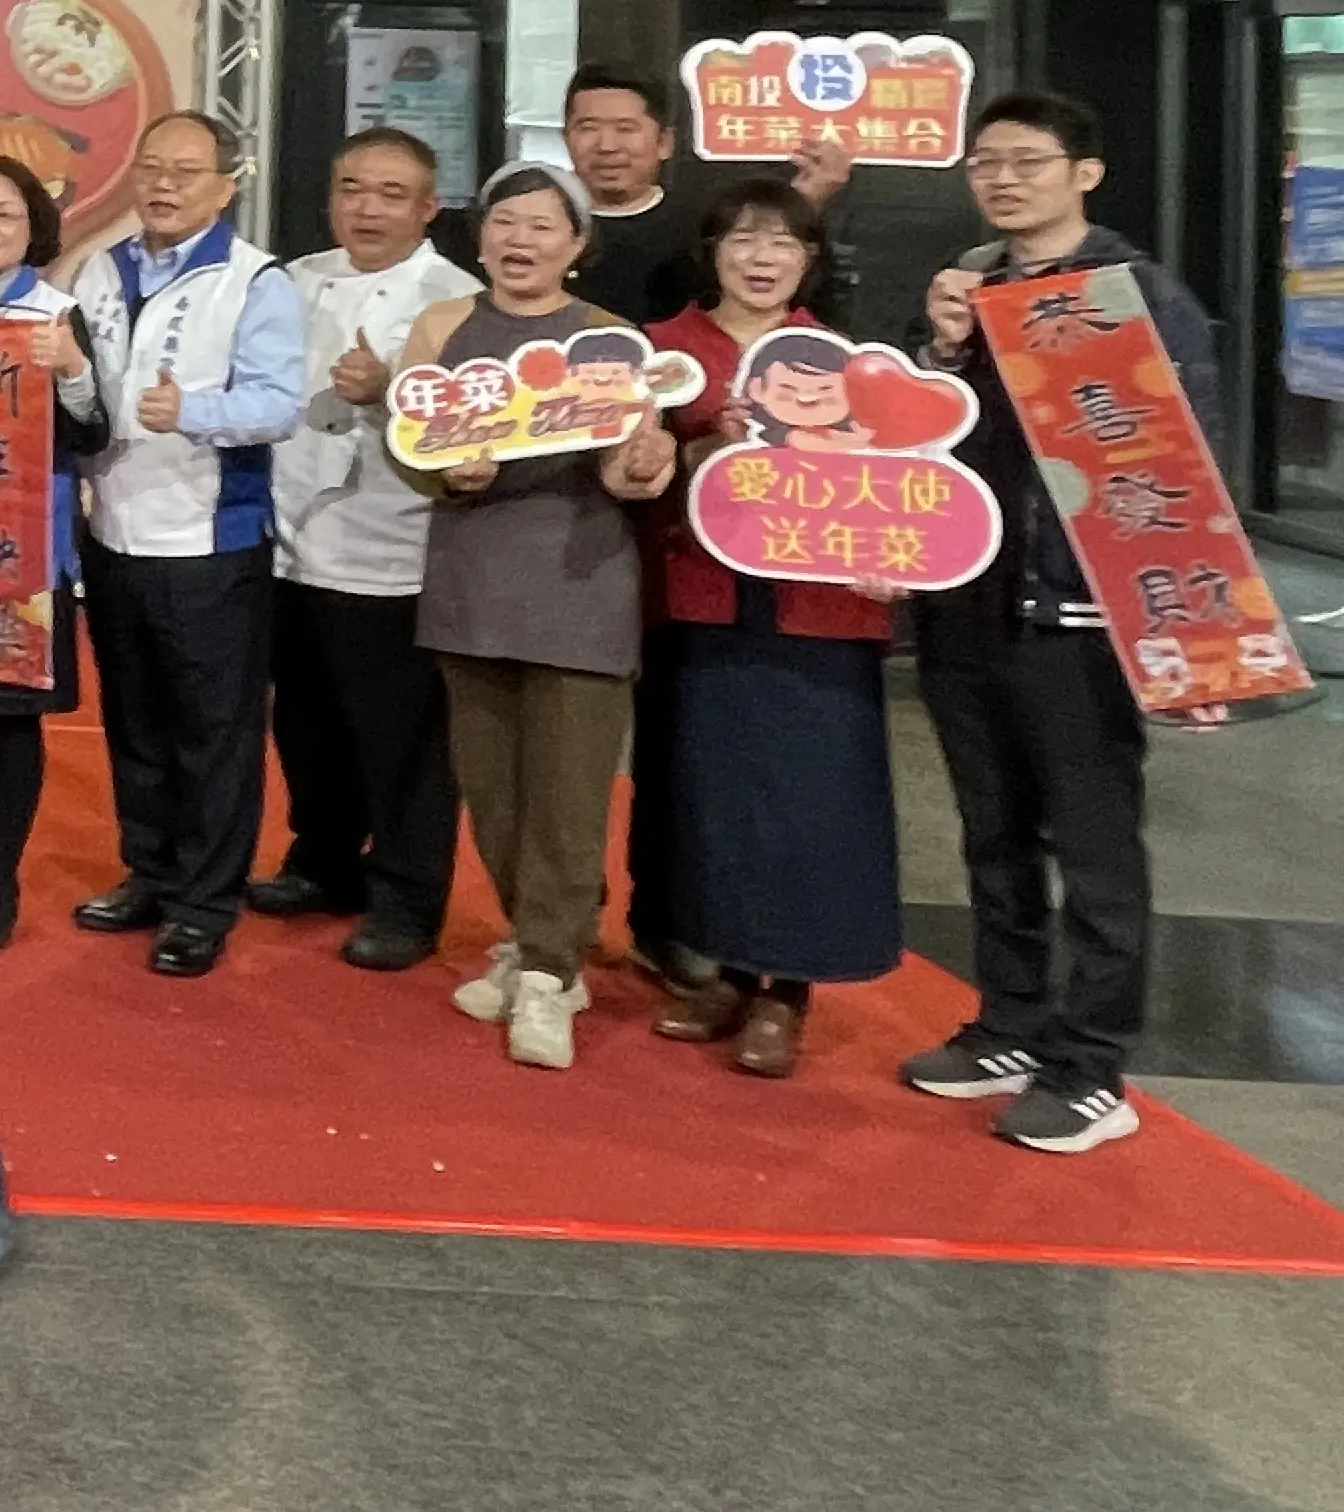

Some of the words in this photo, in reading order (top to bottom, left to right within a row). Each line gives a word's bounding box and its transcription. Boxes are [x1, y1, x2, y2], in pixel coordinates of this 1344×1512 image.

[707, 75, 784, 107] 南投
[716, 114, 947, 154] 年菜大集合
[400, 369, 507, 418] 年菜
[727, 457, 951, 516] 愛心大使
[761, 516, 930, 573] 送年菜
